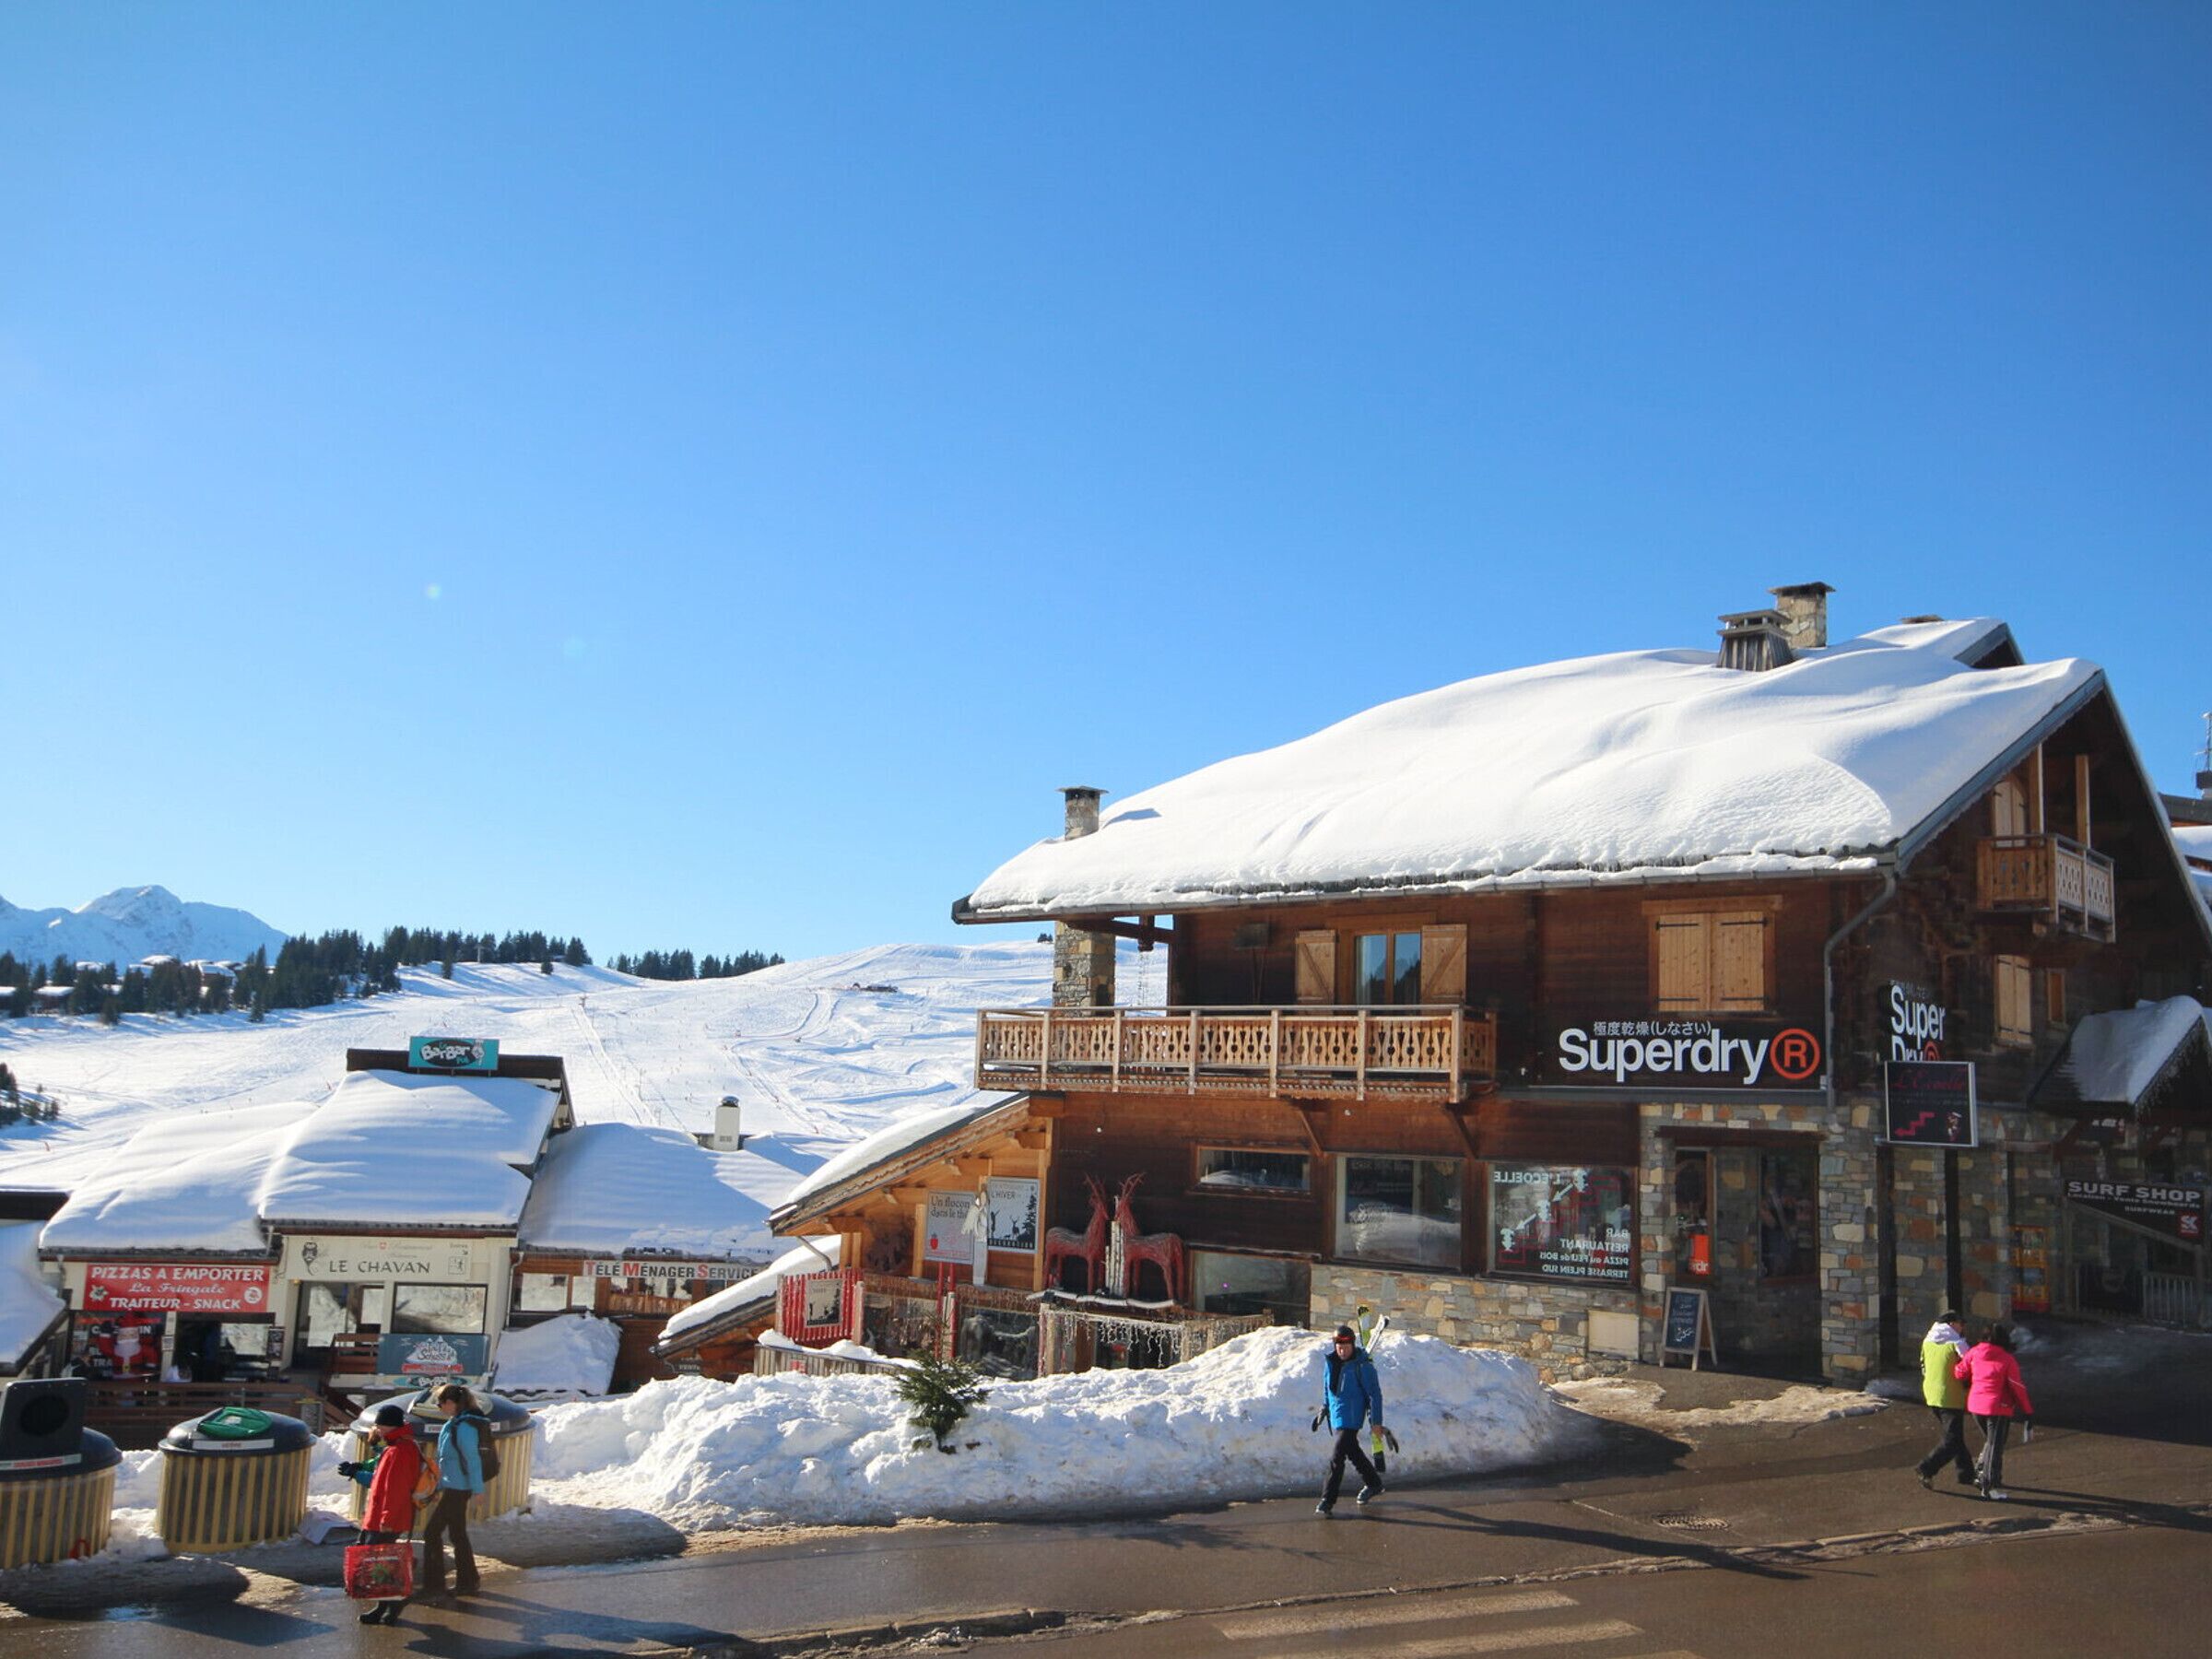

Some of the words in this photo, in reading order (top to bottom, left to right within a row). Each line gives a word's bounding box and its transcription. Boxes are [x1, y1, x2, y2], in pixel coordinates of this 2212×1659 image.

[1891, 984, 1946, 1049] Super
[2067, 1181, 2131, 1196] SURF
[2136, 1187, 2201, 1202] SHOP
[91, 1266, 152, 1280] PIZZAS
[157, 1267, 167, 1279] A
[172, 1267, 265, 1281] EMPORTER
[329, 1260, 348, 1273] LE
[358, 1261, 430, 1274] CHAVAN
[129, 1282, 151, 1292] La
[157, 1282, 225, 1295] Fringale
[109, 1297, 180, 1309] TRAITEUR
[194, 1299, 241, 1309] SNACK
